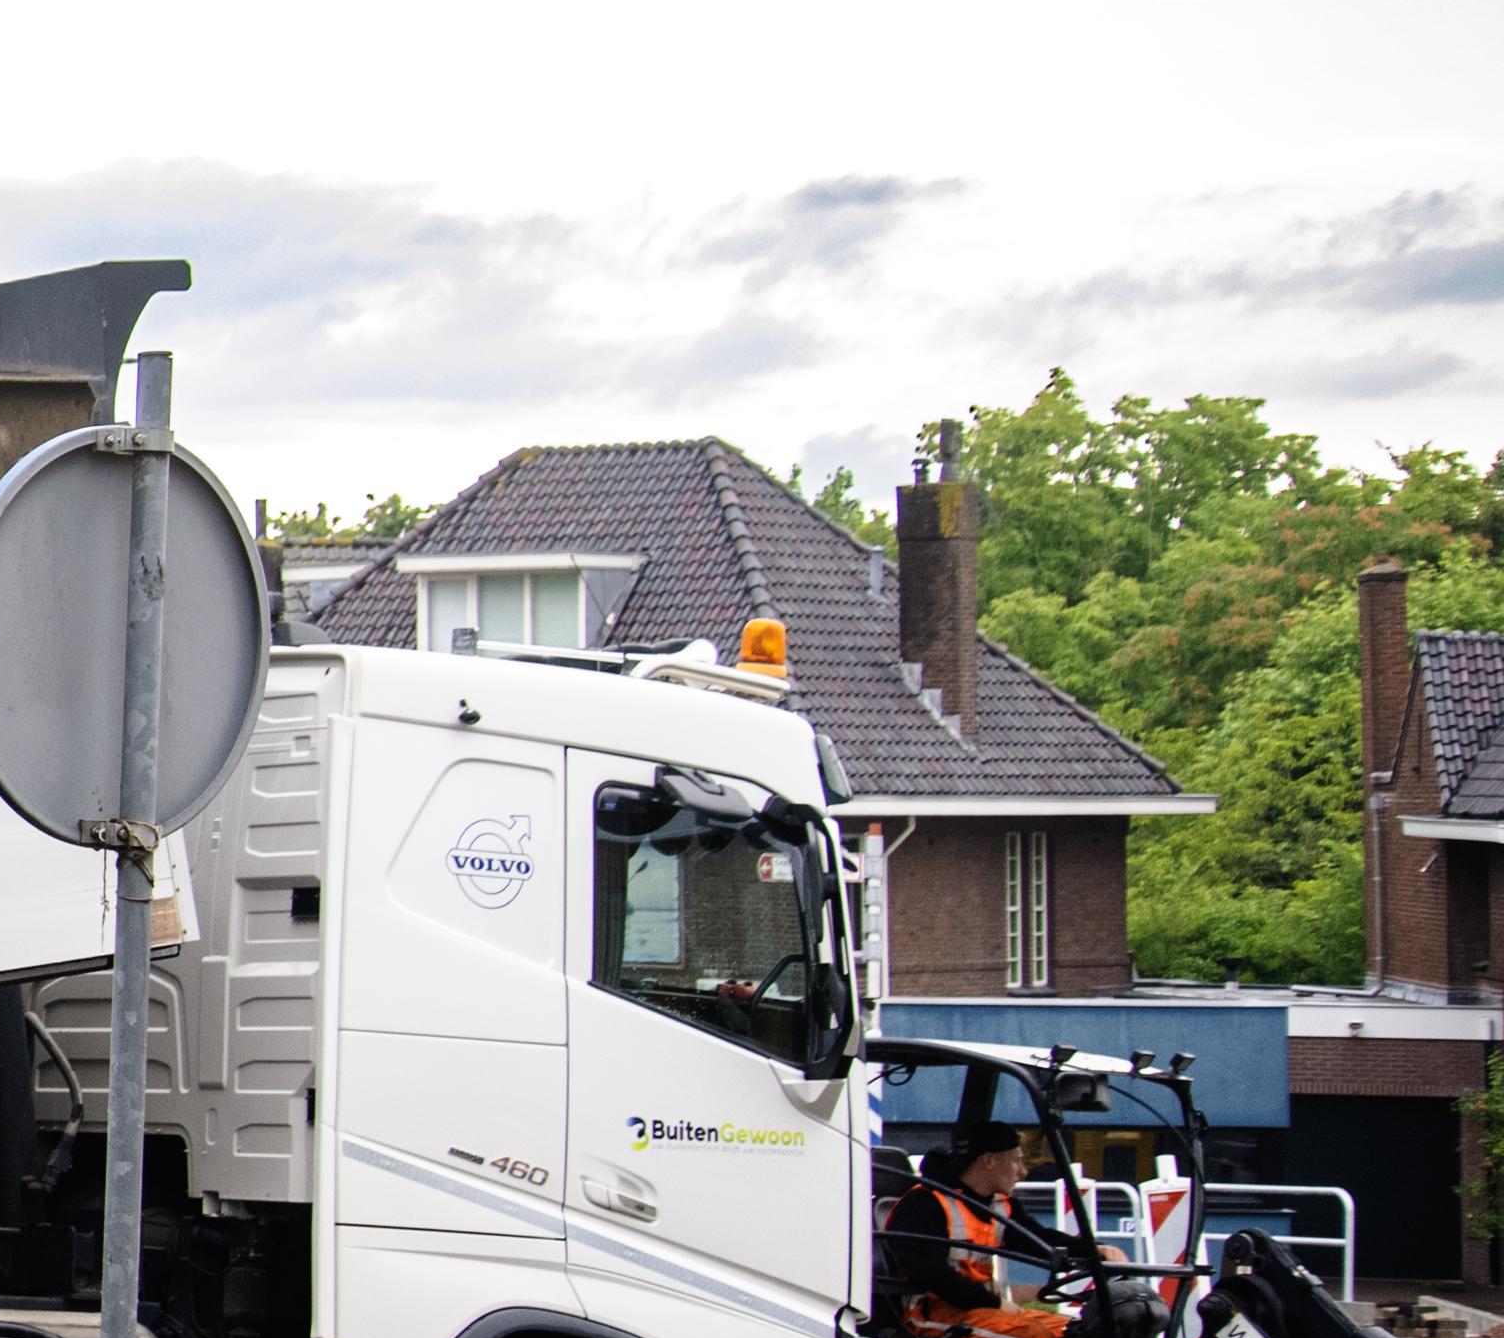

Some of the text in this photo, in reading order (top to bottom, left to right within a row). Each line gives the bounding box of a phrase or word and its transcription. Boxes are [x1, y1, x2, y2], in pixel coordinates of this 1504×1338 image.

[451, 855, 531, 875] VOLVO
[651, 1120, 805, 1147] BuitenGewoon
[490, 1156, 550, 1186] 460
